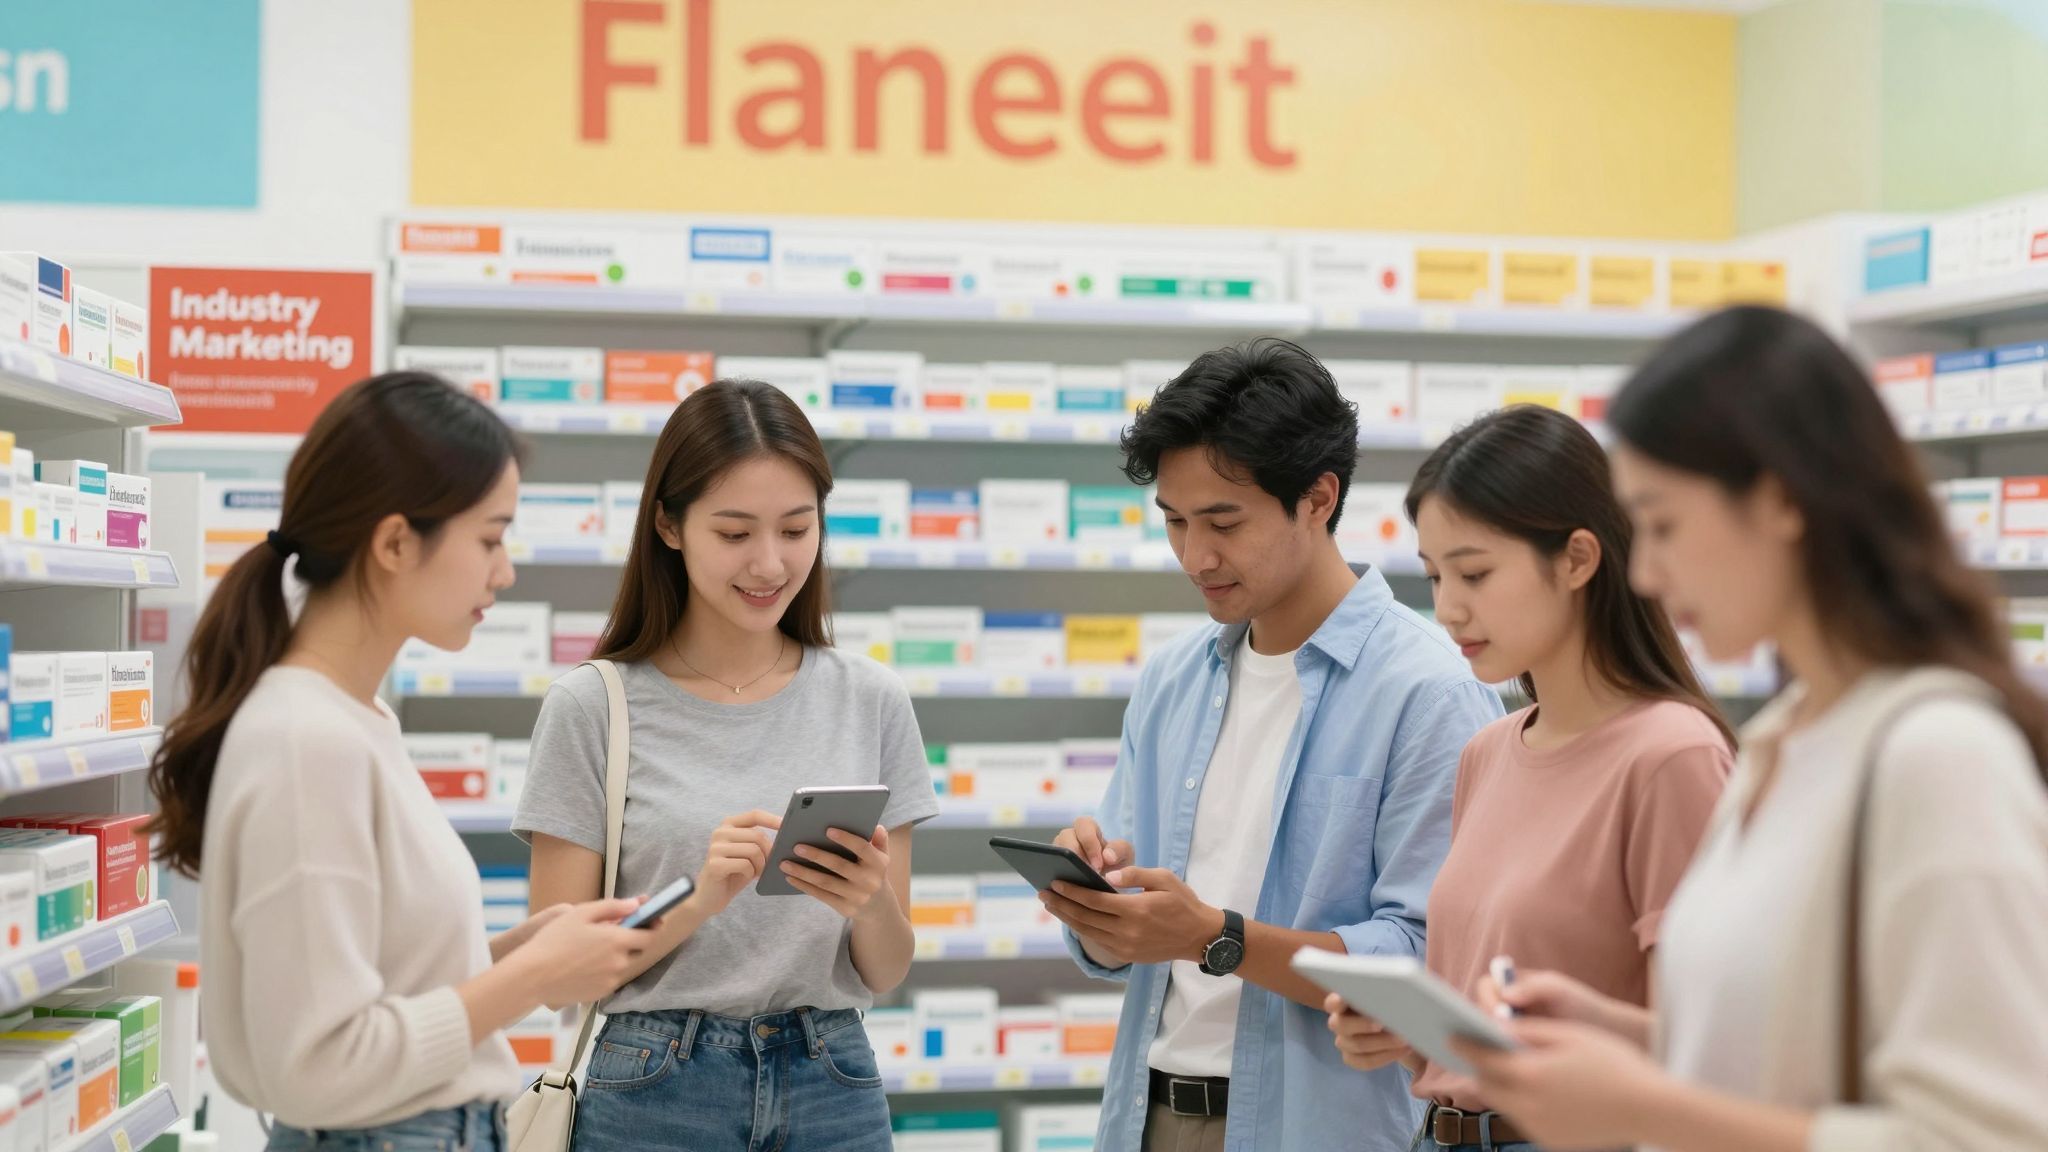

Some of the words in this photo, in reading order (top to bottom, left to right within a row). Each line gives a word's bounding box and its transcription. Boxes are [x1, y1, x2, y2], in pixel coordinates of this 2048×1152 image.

[578, 0, 1297, 170] Flaneeit
[170, 287, 320, 327] Industry
[169, 325, 353, 369] Marketing
